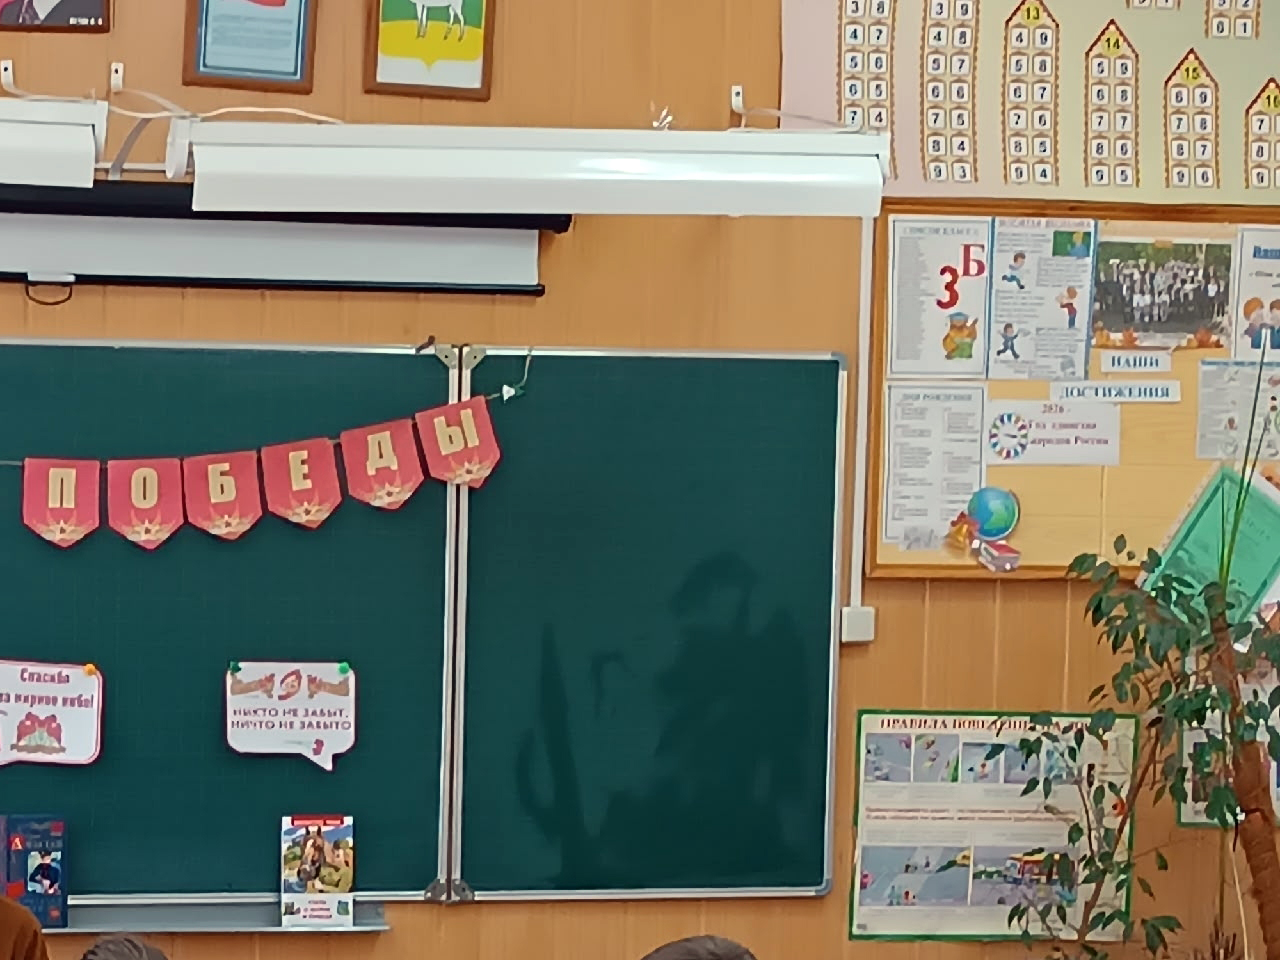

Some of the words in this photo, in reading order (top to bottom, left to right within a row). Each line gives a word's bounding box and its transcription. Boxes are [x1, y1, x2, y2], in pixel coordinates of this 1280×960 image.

[1026, 6, 1040, 20] 13
[850, 28, 858, 40] 4
[874, 28, 883, 41] 7
[933, 30, 942, 42] 4
[1015, 31, 1024, 44] 4
[1104, 37, 1121, 50] 14
[956, 59, 965, 70] 7
[1184, 66, 1201, 80] 15
[1038, 86, 1047, 100] 7
[849, 110, 857, 121] 7
[874, 111, 883, 123] 4
[931, 112, 940, 125] 7
[1012, 113, 1021, 125] 7
[1095, 115, 1104, 127] 7
[1119, 115, 1128, 128] 7
[1176, 117, 1184, 130] 7
[1256, 118, 1264, 131] 7
[957, 140, 966, 152] 4
[1198, 144, 1207, 156] 7
[1039, 168, 1048, 179] 4
[936, 265, 959, 309] 3
[961, 243, 986, 277] Б
[1111, 355, 1159, 368] НАШИ
[1060, 386, 1170, 399] ДОСТИЖЕНИЯ
[48, 408, 481, 510] ПОБЕДЫ
[19, 667, 70, 684] Спасибо
[232, 707, 279, 718] НИКТО
[282, 707, 299, 718] НЕ
[231, 720, 276, 730] НИЧТО
[279, 720, 295, 730] НЕ
[299, 720, 352, 730] ЗАБЫТО
[880, 718, 949, 729] ПРАВИЛА
